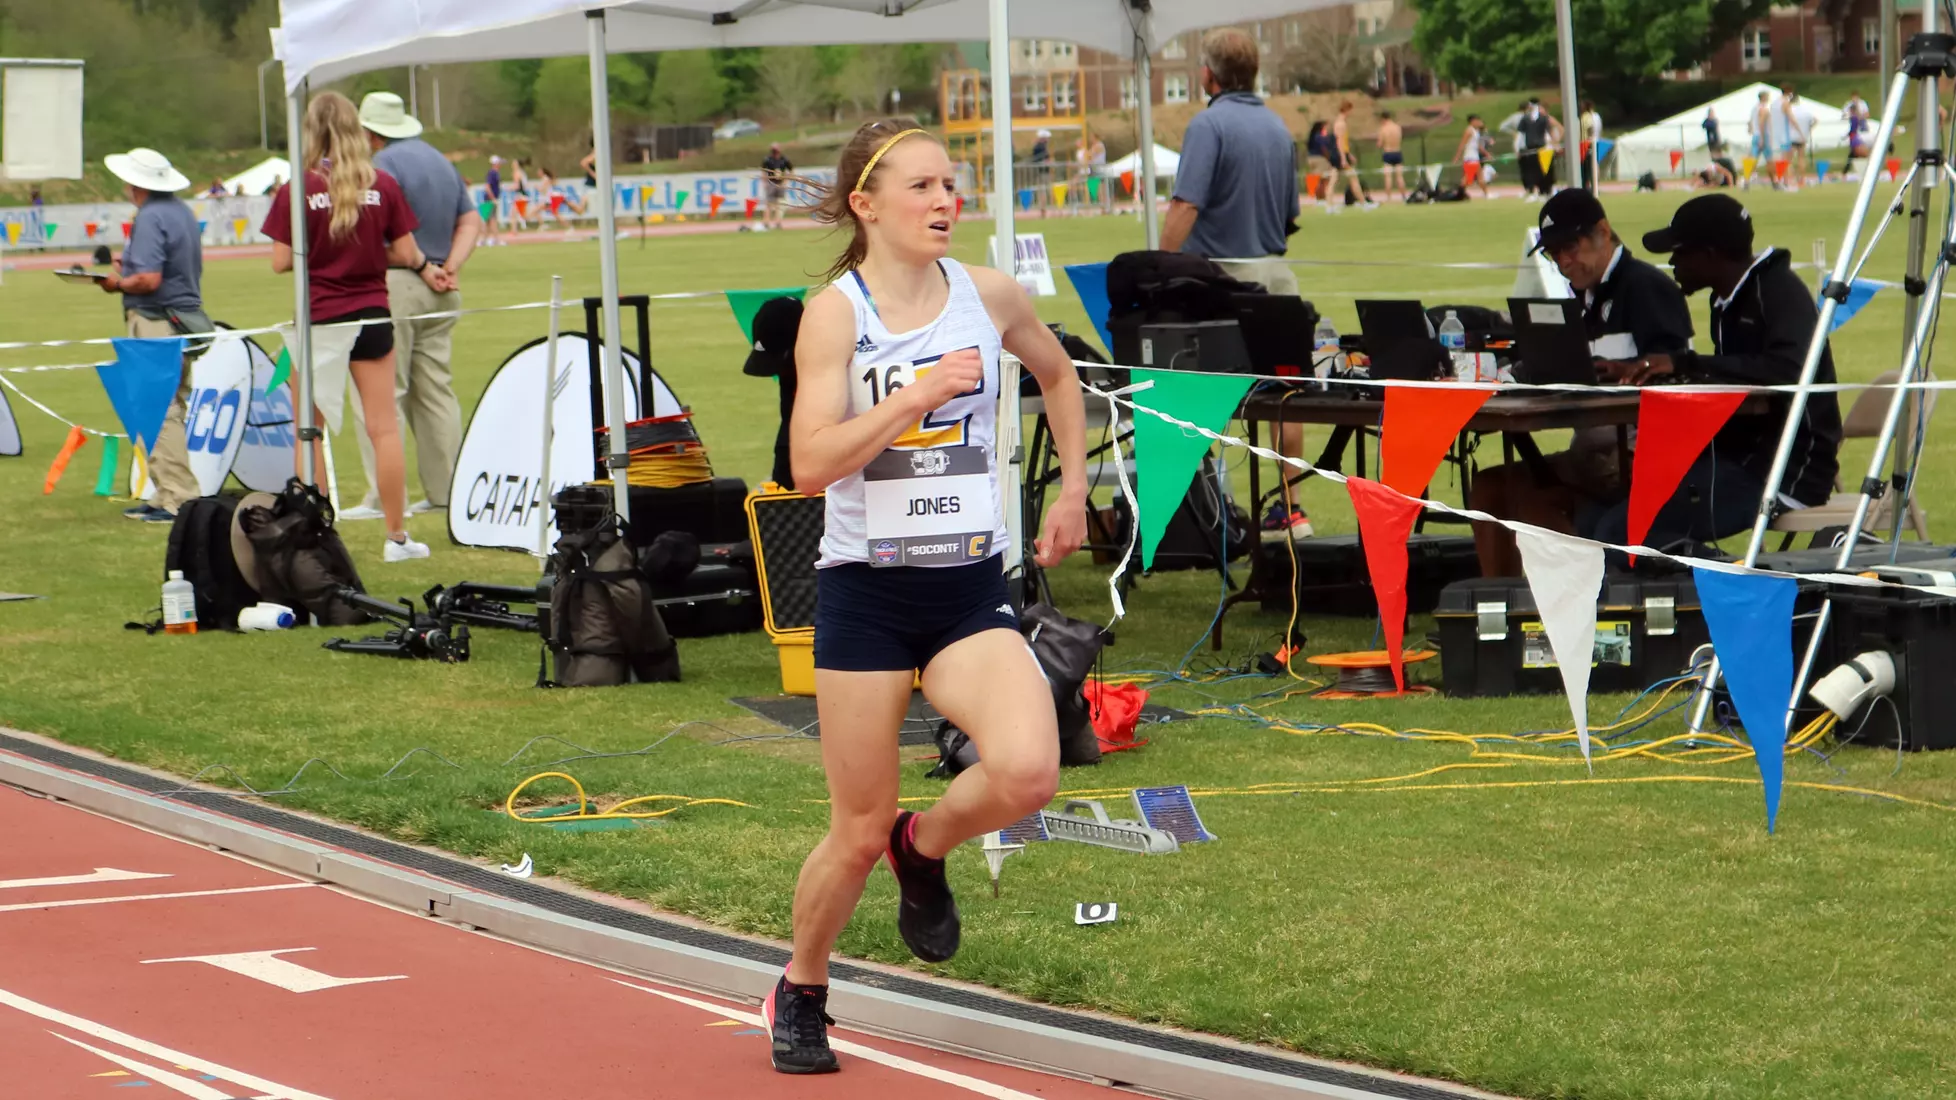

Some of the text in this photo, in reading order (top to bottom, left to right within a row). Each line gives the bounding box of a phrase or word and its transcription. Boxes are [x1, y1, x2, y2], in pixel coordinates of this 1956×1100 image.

[614, 181, 681, 210] WLL
[906, 496, 960, 516] JONES
[907, 543, 959, 556] #SOCONTF
